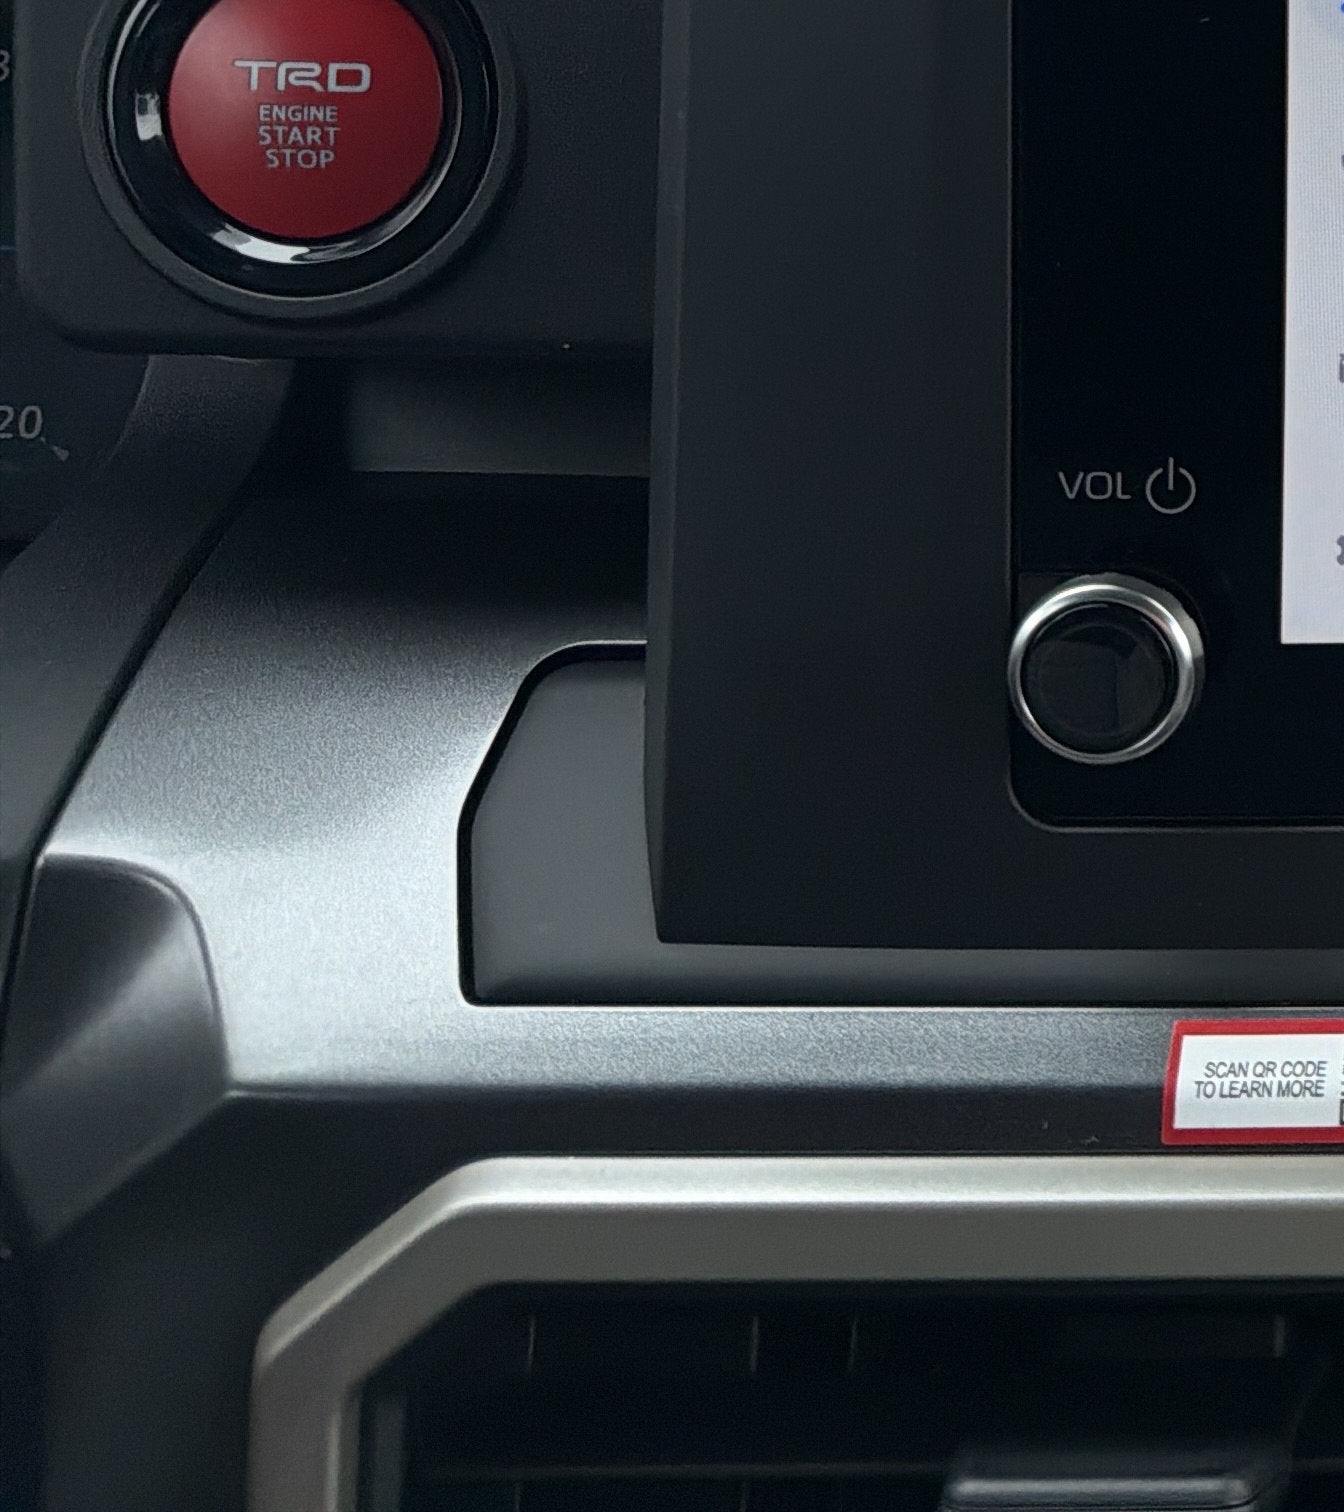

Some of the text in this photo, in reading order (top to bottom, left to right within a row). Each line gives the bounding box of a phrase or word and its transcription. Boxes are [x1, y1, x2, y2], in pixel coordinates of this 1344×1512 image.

[234, 60, 371, 92] TRD
[259, 104, 338, 122] ENGINE
[258, 126, 340, 146] START
[266, 149, 335, 168] STOP
[1058, 471, 1132, 500] VOL
[1204, 1060, 1329, 1078] SCAN QR CODE
[1194, 1079, 1326, 1099] TO LEARN MORE
